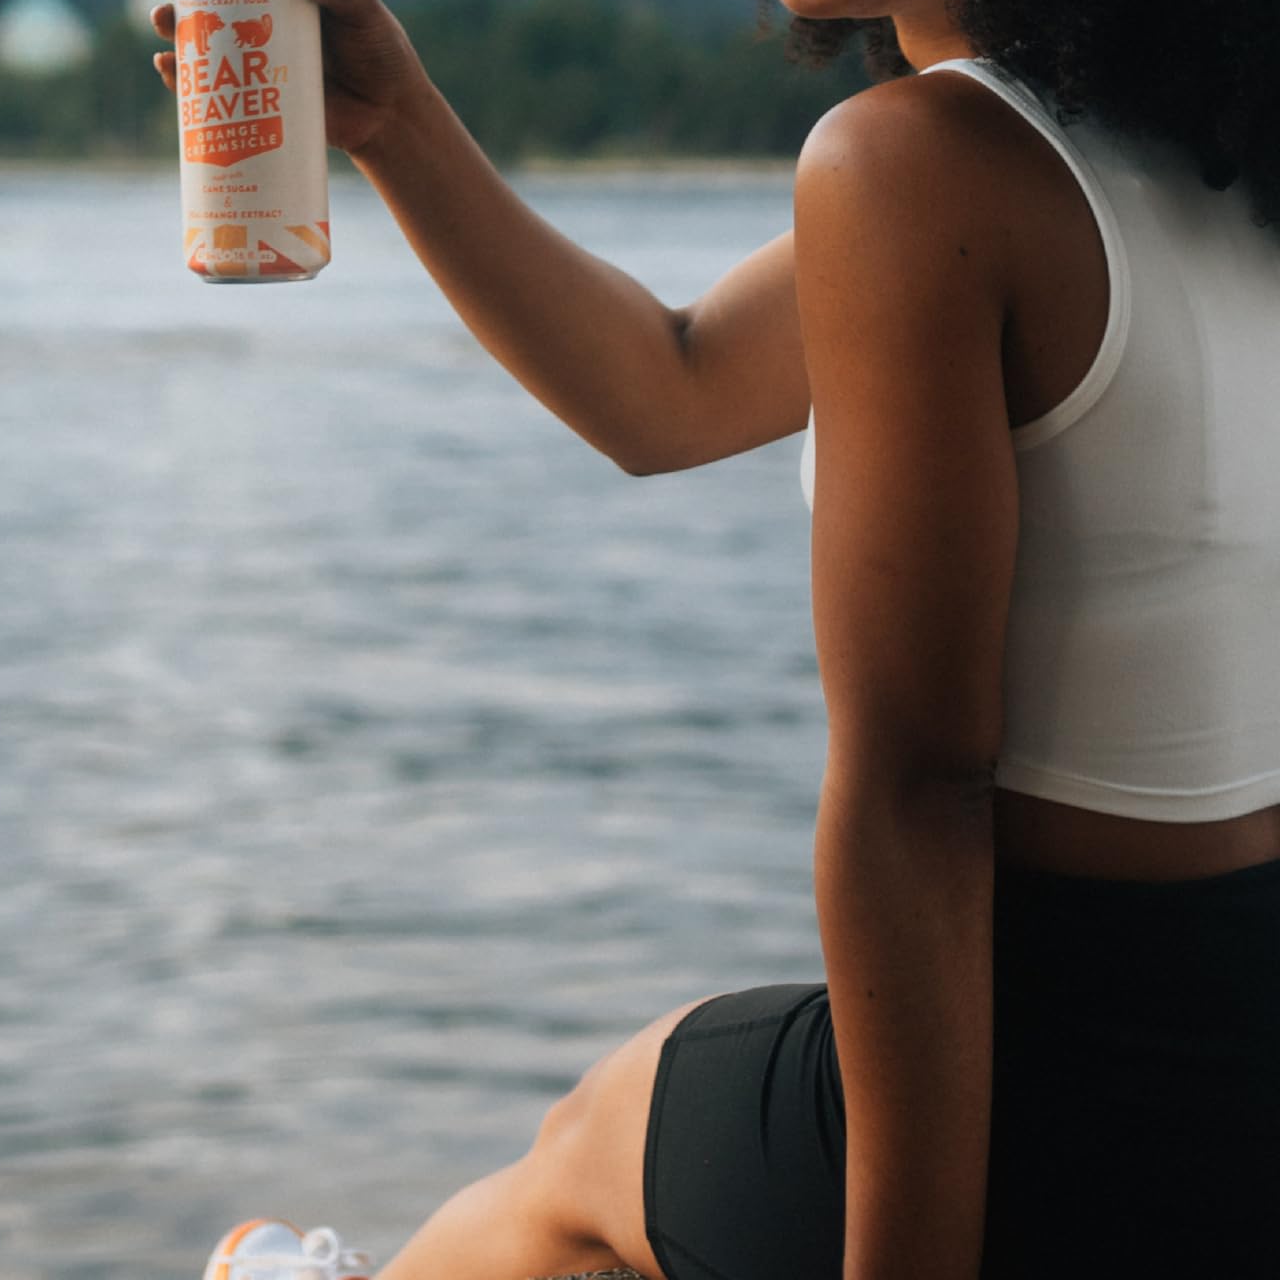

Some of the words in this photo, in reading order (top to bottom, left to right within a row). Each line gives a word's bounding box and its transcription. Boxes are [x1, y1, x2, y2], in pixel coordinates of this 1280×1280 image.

[180, 51, 269, 97] BEAR
[183, 87, 280, 127] BEAVER
[187, 133, 277, 159] CREAMSICLE
[197, 125, 258, 143] ORANGE
[226, 183, 258, 193] SUGAR
